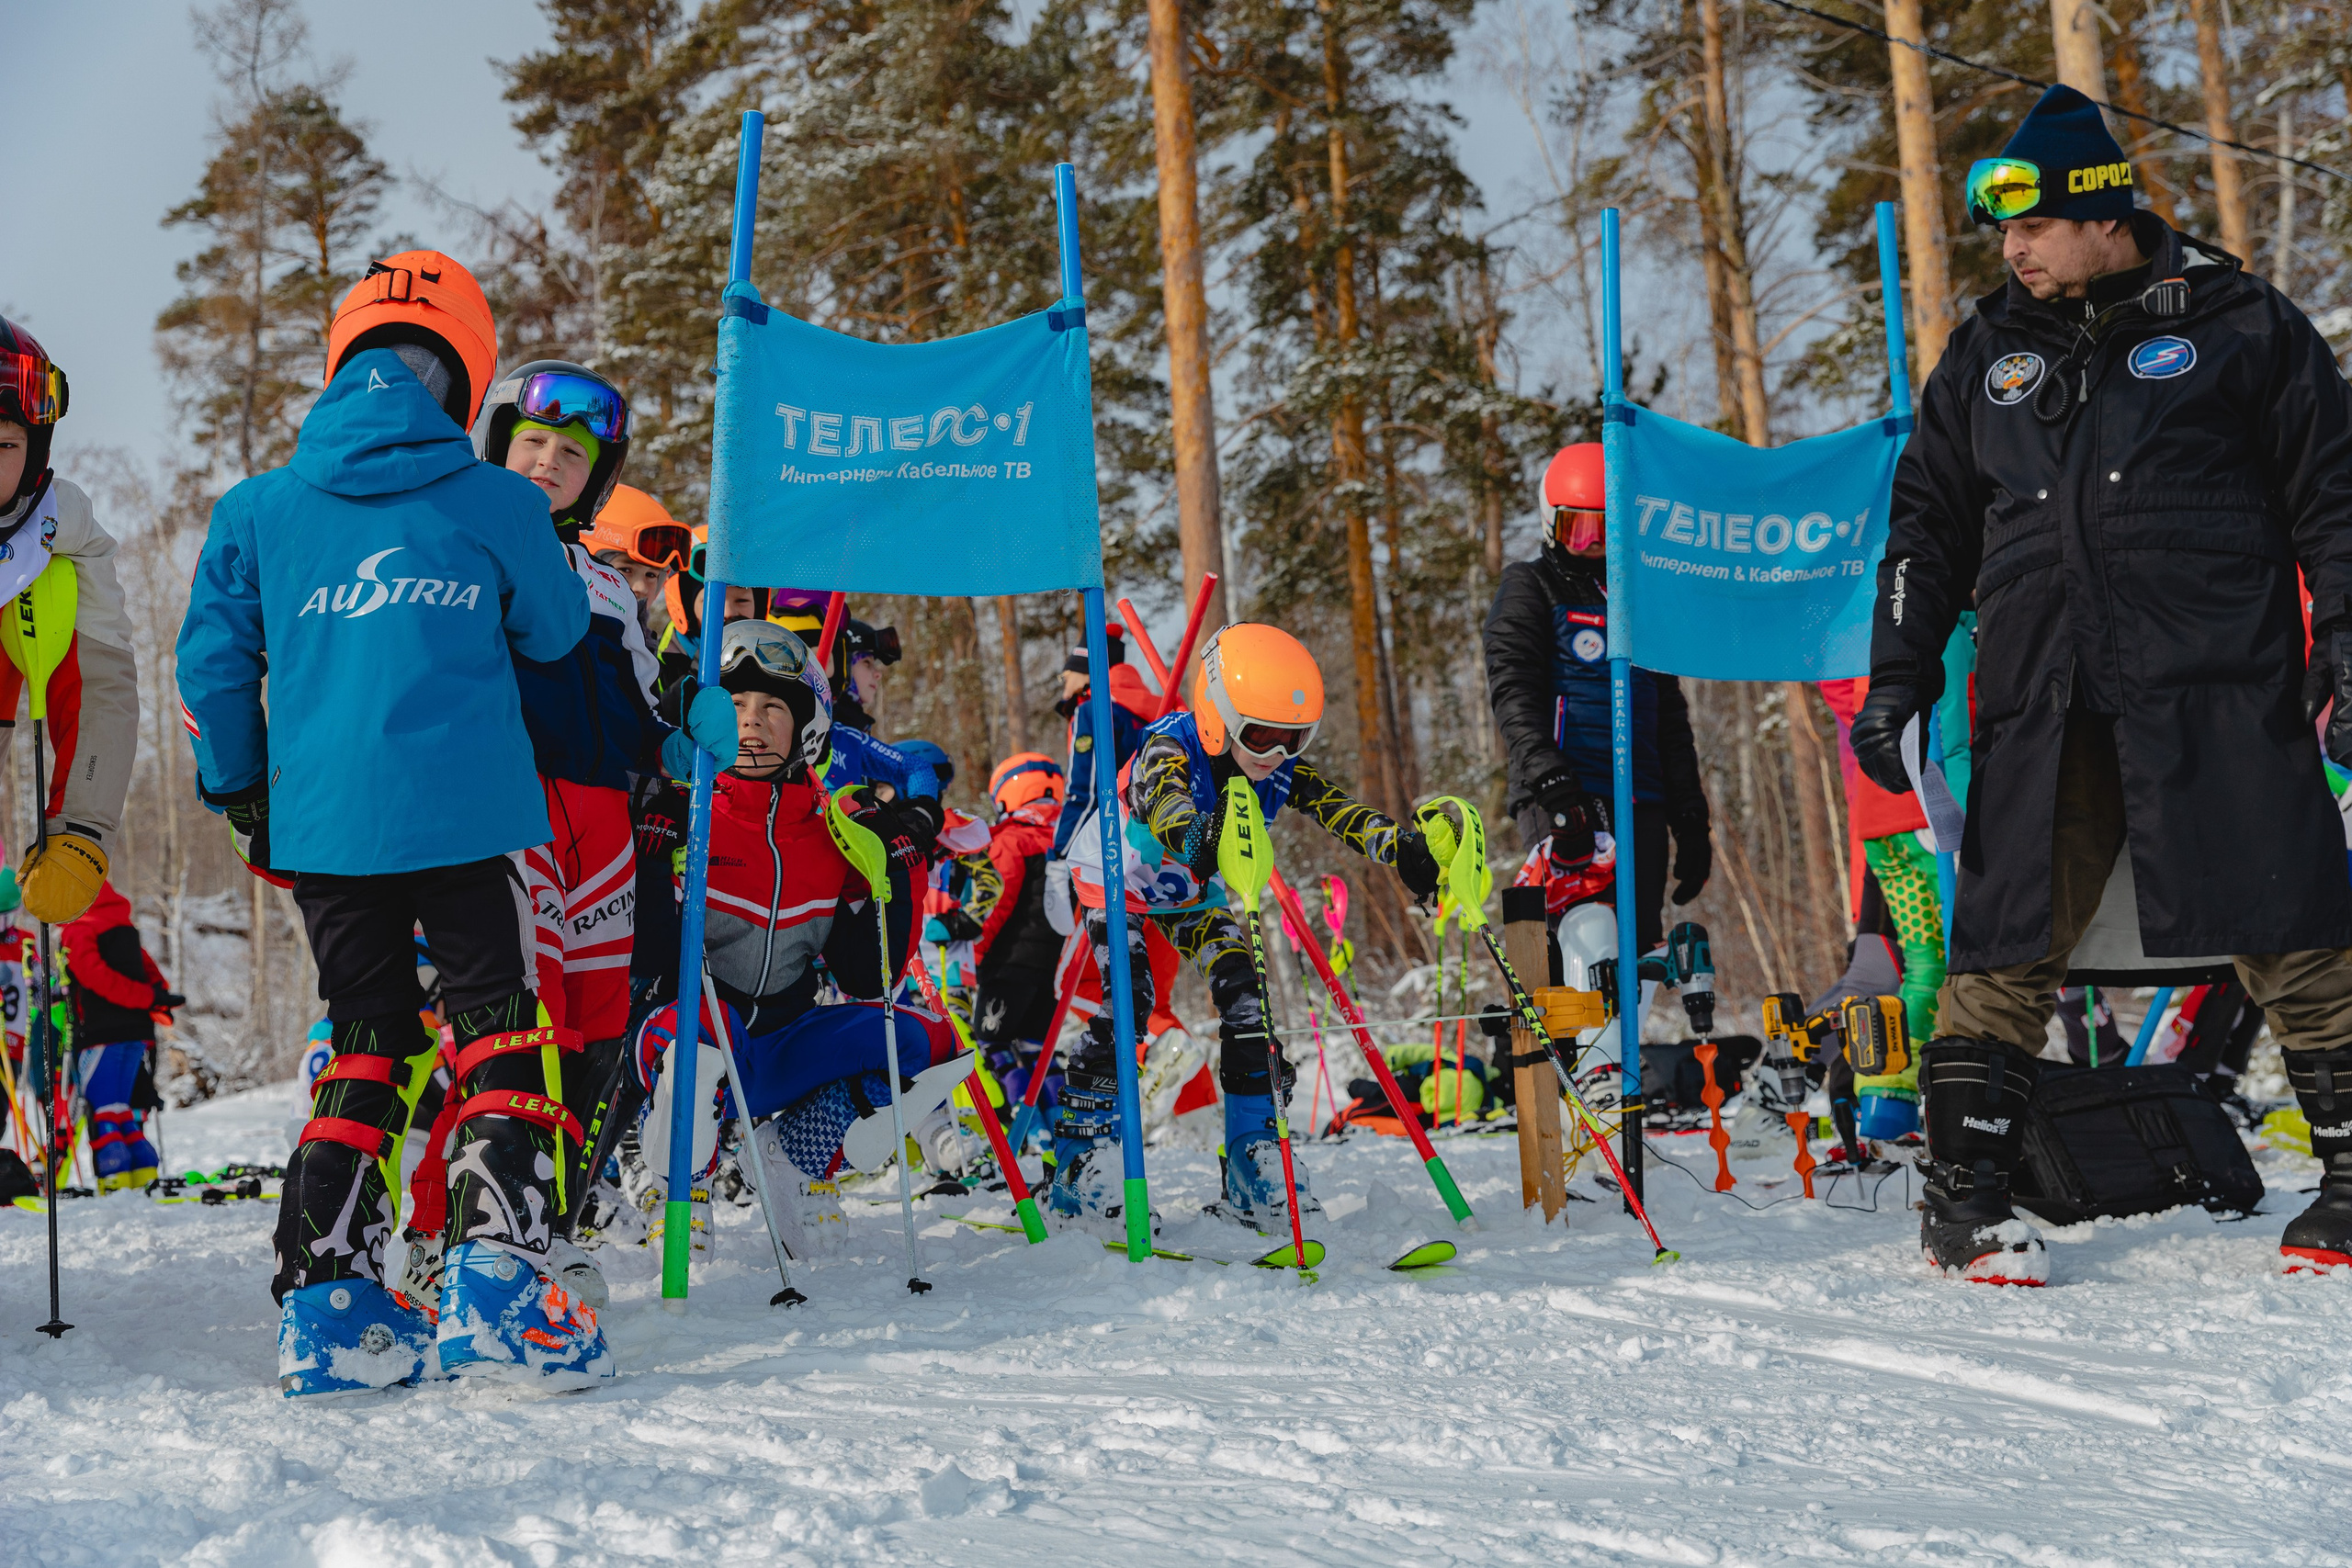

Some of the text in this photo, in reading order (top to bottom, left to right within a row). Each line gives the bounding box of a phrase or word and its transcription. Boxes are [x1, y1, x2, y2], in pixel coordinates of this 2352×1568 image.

[897, 461, 998, 479] Кабельное
[1004, 462, 1032, 479] ТВ
[298, 547, 481, 619] AUSTRIA
[1734, 566, 1746, 581] &
[1748, 566, 1837, 582] Кабельное
[1841, 560, 1865, 577] ТВ
[20, 583, 36, 639] LEK
[636, 824, 678, 840] MONSTER
[1234, 791, 1253, 860] LEKI
[1468, 807, 1483, 874] LEKI
[1250, 919, 1266, 974] LEKI
[1514, 992, 1553, 1045] LEKI
[493, 1029, 555, 1050] LEKI
[508, 1095, 569, 1122] LEKI
[1962, 1115, 1999, 1134] Helios
[579, 1100, 607, 1171] LEKI
[2313, 1125, 2351, 1138] Helios
